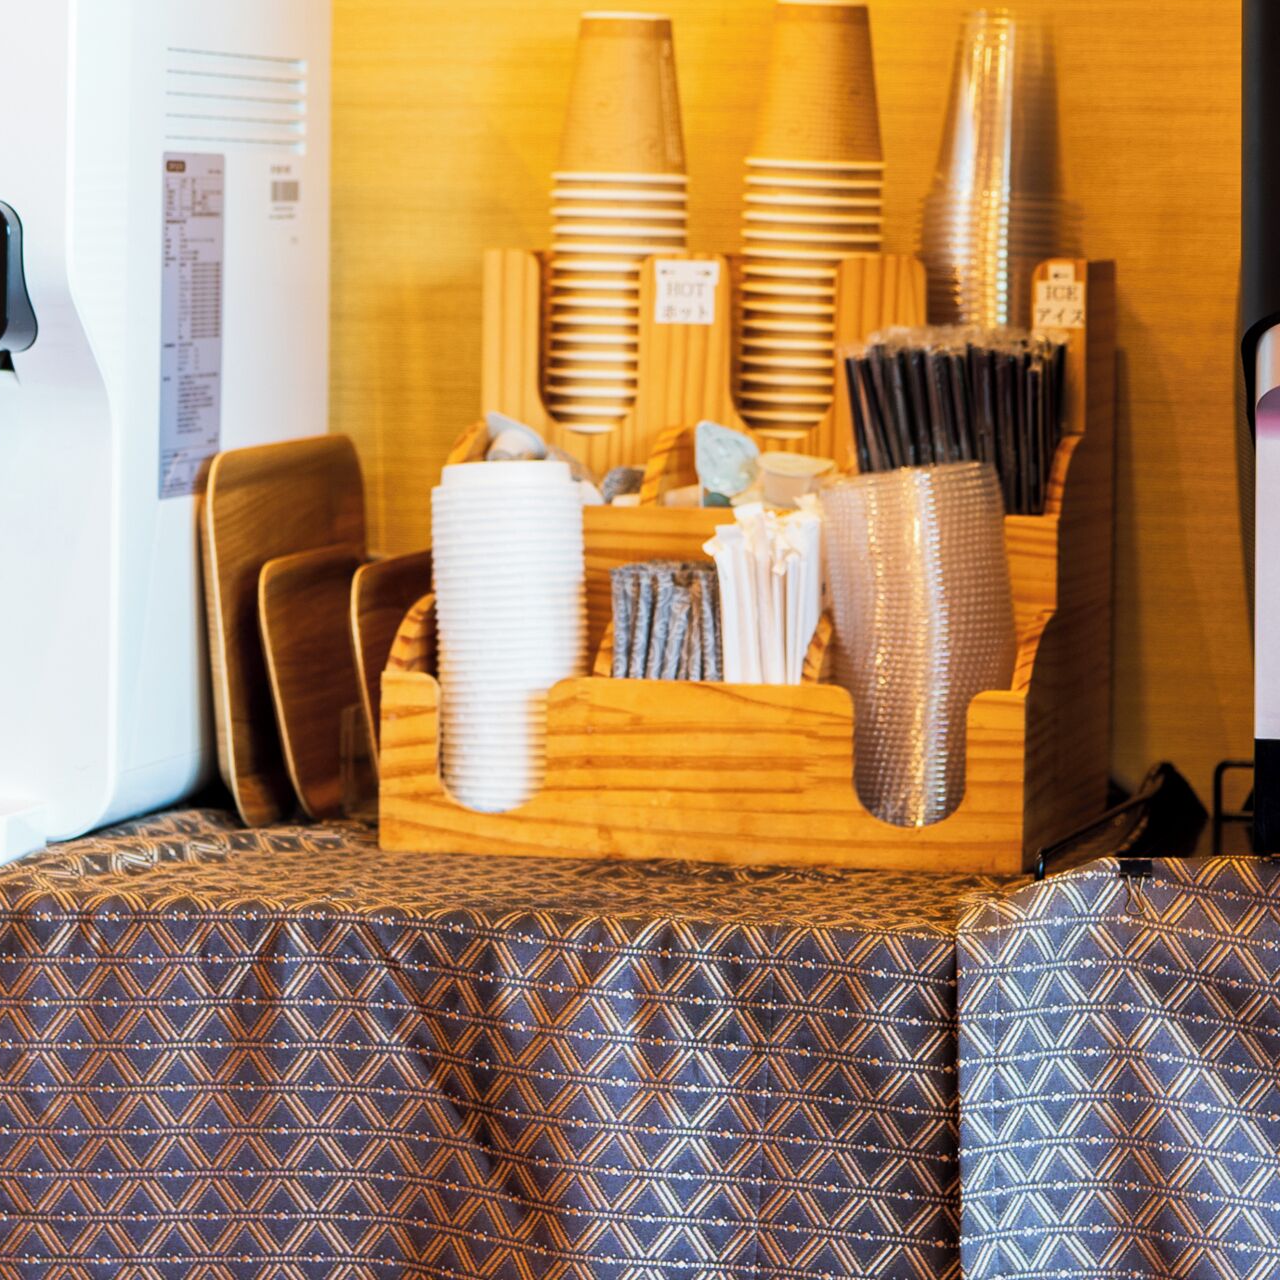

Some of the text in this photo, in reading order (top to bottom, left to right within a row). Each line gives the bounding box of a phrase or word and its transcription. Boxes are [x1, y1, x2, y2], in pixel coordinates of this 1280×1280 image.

[666, 282, 705, 298] HOT
[1046, 285, 1079, 301] ICE
[1037, 307, 1084, 325] アイス
